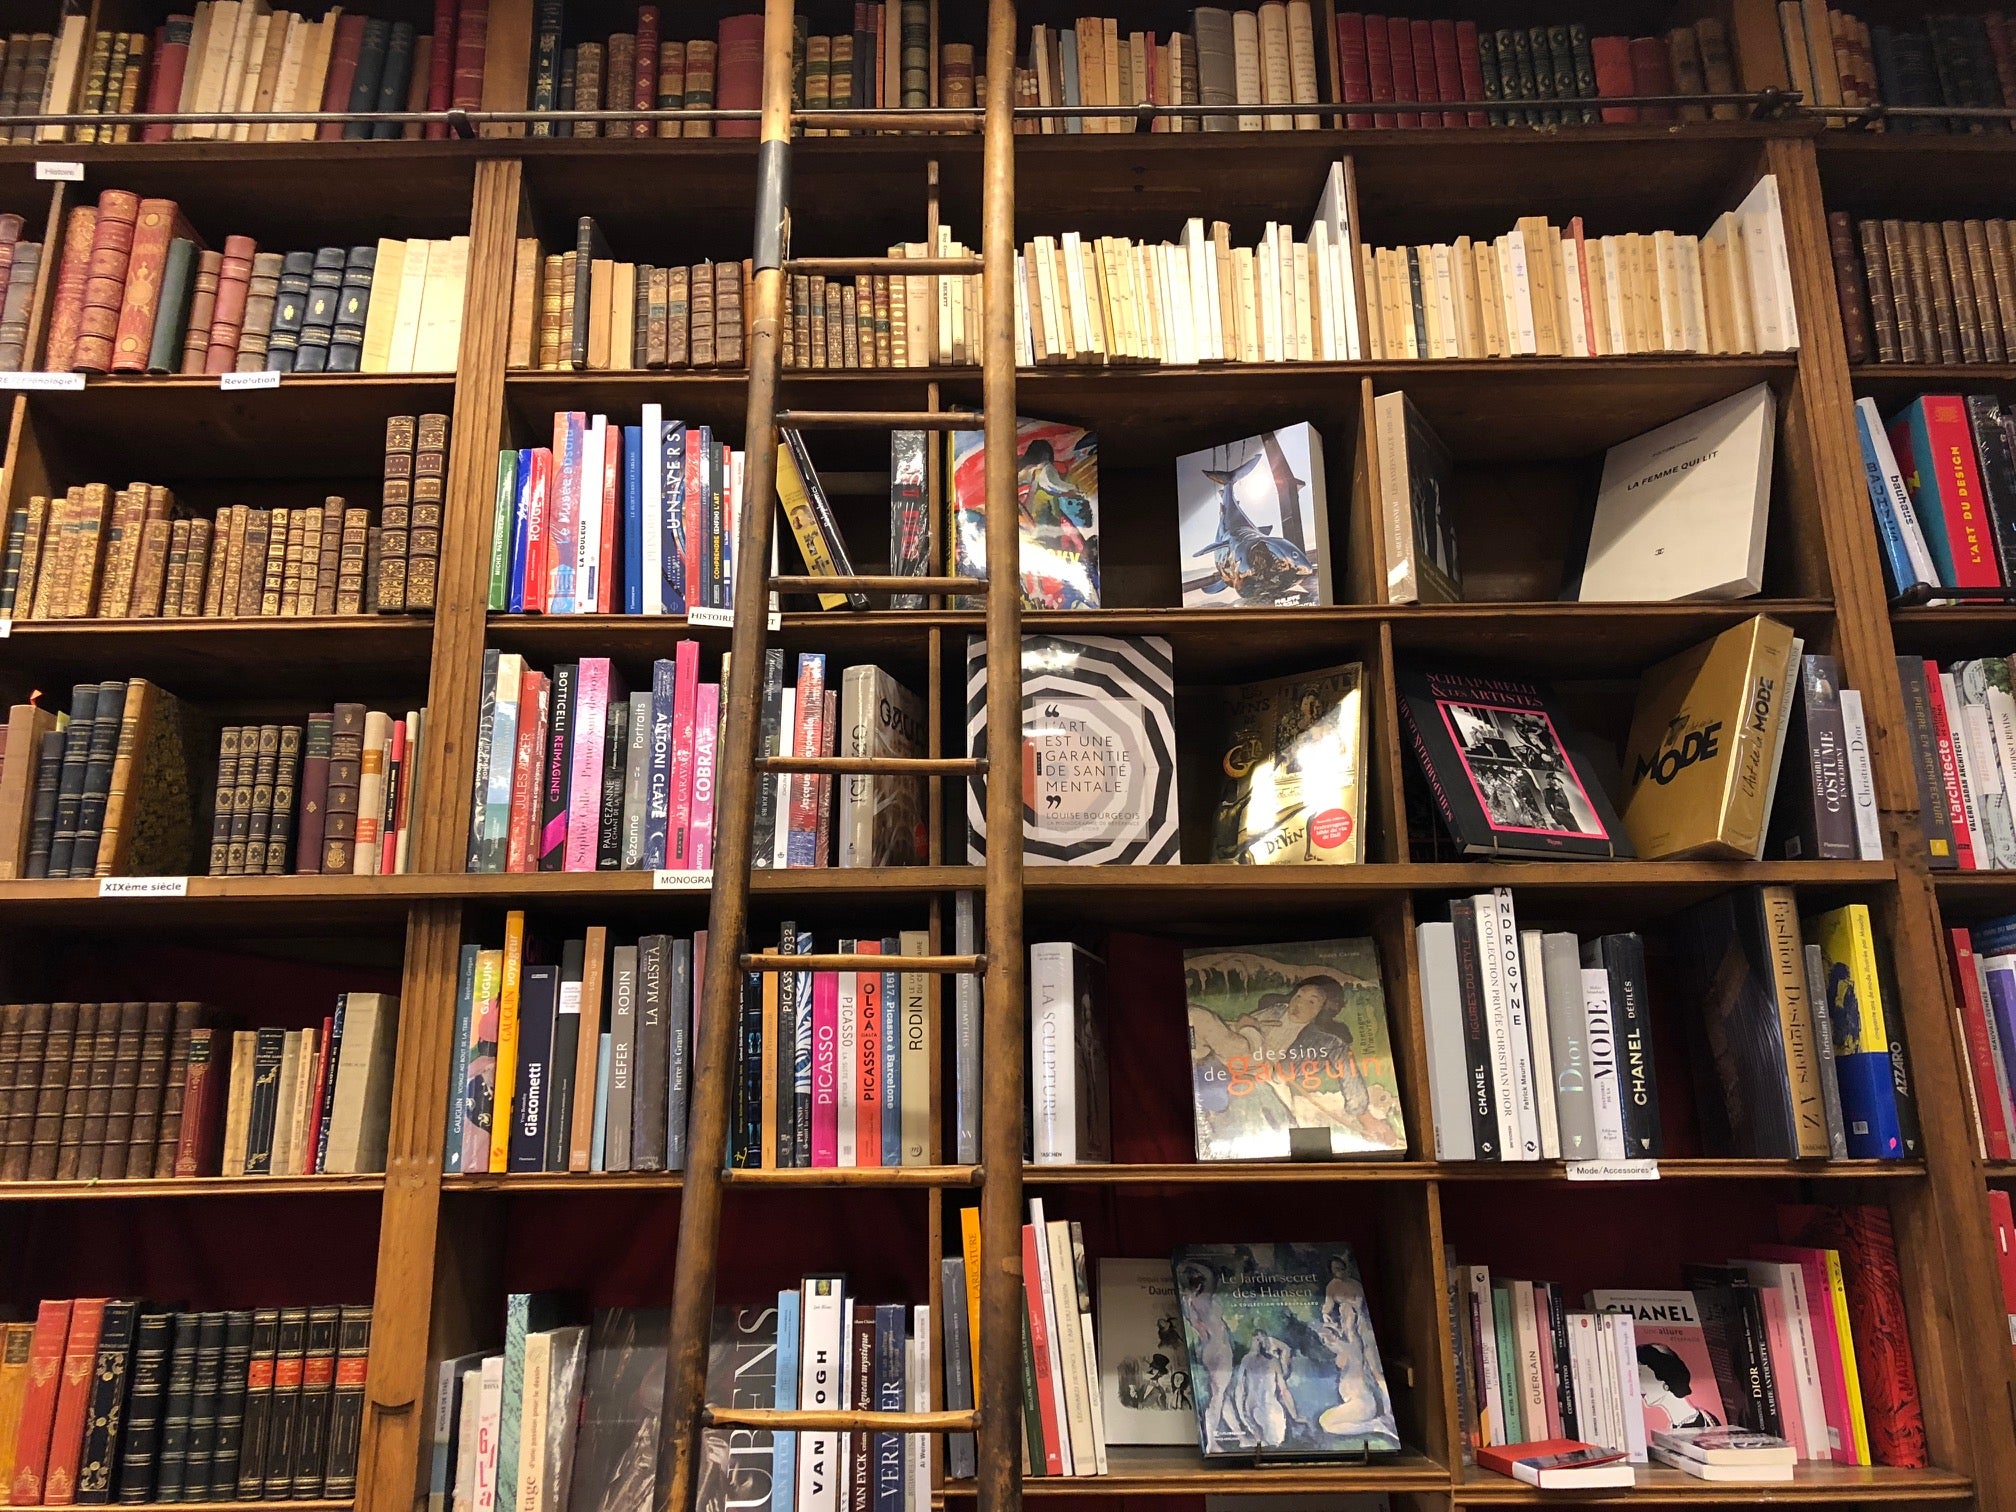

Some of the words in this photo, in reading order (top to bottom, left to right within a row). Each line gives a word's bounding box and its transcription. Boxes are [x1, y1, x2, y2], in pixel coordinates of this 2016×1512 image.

[666, 433, 681, 530] UNIVERS
[1627, 481, 1640, 491] LA
[1642, 466, 1679, 486] FEMME
[1681, 458, 1700, 470] QUI
[1702, 450, 1719, 462] LIT
[1951, 446, 1968, 497] DESIGN
[1890, 474, 1913, 525] bauhaus
[1960, 502, 1974, 520] DU
[580, 559, 585, 568] LA
[1966, 526, 1981, 563] L'ART
[554, 672, 569, 731] BOTTICELLI
[1426, 672, 1537, 696] SCHIAPARELLI
[1432, 684, 1448, 698] &
[1470, 690, 1544, 708] ARTISTES
[1910, 680, 1919, 694] LA
[1752, 676, 1774, 734] MODE
[1914, 698, 1926, 731] PIERRE
[654, 712, 668, 769] ANTONI
[1046, 720, 1087, 732] L'ART
[1046, 736, 1072, 747] EST
[1080, 736, 1113, 747] UNE
[1852, 726, 1865, 753] Dior
[1920, 733, 1930, 748] EN
[696, 742, 713, 802] COBRA
[1045, 750, 1131, 762] GARANTIE
[1046, 766, 1066, 777] DE
[1074, 763, 1128, 777] SANTÉ
[1632, 720, 1723, 787] MODE
[1820, 730, 1841, 814] COSTUME
[1836, 748, 1846, 789] OCCIDENT
[1953, 732, 1967, 777] ARCHITECTES
[515, 775, 529, 810] JULES
[626, 815, 639, 865] Cézanne
[633, 702, 646, 750] Portraits
[1814, 767, 1824, 796] HISTOIRE
[1840, 789, 1848, 799] EN
[1857, 756, 1873, 809] Christian
[1925, 750, 1945, 825] ARCHITECTURE
[1939, 739, 1964, 825] L'architecte
[576, 818, 588, 864] Sophie
[582, 740, 593, 778] Prenez
[604, 780, 614, 825] CEZANNE
[1046, 812, 1081, 820] LOUISE
[1083, 812, 1141, 820] BOURGEOIS
[1966, 804, 1977, 832] VALERO
[603, 827, 611, 849] PAUL
[104, 882, 148, 892] XIXème
[151, 882, 182, 892] siècle
[662, 876, 713, 885] MONOGRA
[1482, 906, 1491, 919] LA
[784, 928, 795, 955] 1932
[1462, 937, 1473, 975] STYLE
[1484, 920, 1498, 987] COLLECTION
[1500, 887, 1521, 1026] ANDROGYNE
[1773, 900, 1794, 976] Fashion
[508, 934, 519, 986] voyageur
[647, 946, 661, 1001] MAESTÀ
[480, 961, 493, 1015] GAUGUIN
[618, 970, 631, 1015] RODIN
[782, 971, 794, 1013] PICASS
[886, 972, 895, 999] 1917.
[1042, 984, 1055, 1005] LA
[1466, 973, 1475, 990] DU
[1624, 981, 1635, 1019] DÉFILÉS
[502, 991, 515, 1042] GAUGUIN
[646, 1005, 658, 1027] LA
[842, 996, 853, 1047] PICASSO
[887, 1002, 895, 1043] Picasso
[910, 996, 923, 1051] RODIN
[1467, 991, 1480, 1040] FIGURES
[1492, 989, 1504, 1027] PRIVÉE
[674, 1029, 683, 1055] Grand
[1252, 1044, 1329, 1062] dessins
[1587, 1000, 1613, 1080] MODE
[1785, 986, 1809, 1085] Designers
[1821, 1021, 1831, 1060] Christian
[1988, 1019, 1998, 1051] MAUVAIS
[615, 1042, 628, 1089] KIEFER
[674, 1056, 682, 1064] le
[818, 1025, 834, 1105] PICASSO
[863, 1040, 875, 1101] PICASSO
[1042, 1012, 1057, 1123] SCULPTURE
[1204, 1062, 1227, 1083] de
[1227, 1052, 1382, 1097] gauguin
[1496, 1028, 1508, 1086] CHRISTIAN
[1520, 1058, 1528, 1087] Mauriès
[1558, 1037, 1584, 1093] Dior
[1628, 1028, 1648, 1106] CHANEL
[1890, 1041, 1909, 1098] AZZARO
[674, 1066, 682, 1091] Pierre
[886, 1054, 895, 1110] Barcelone
[1478, 1065, 1487, 1116] CHANEL
[454, 1098, 463, 1134] GAUGUIN
[524, 1062, 542, 1137] Giacometti
[1502, 1088, 1513, 1117] DIOR
[1800, 1094, 1817, 1106] A
[1803, 1112, 1821, 1129] Z
[970, 1232, 981, 1299] CARICATURE
[1220, 1273, 1237, 1284] Le
[1240, 1272, 1278, 1285] Jardin
[1280, 1272, 1318, 1283] secret
[1148, 1286, 1177, 1296] Daum
[1232, 1288, 1257, 1299] des
[1260, 1286, 1313, 1298] Hansen
[859, 1332, 871, 1372] mystique
[1658, 1328, 1684, 1336] allure
[1528, 1350, 1542, 1405] GUERLAIN
[1562, 1364, 1570, 1389] TATTOO
[1749, 1366, 1763, 1399] DIOR
[881, 1380, 900, 1498] VERMER
[813, 1440, 824, 1495] VAN
[857, 1454, 866, 1483] EYCK
[856, 1485, 866, 1511] VAN
